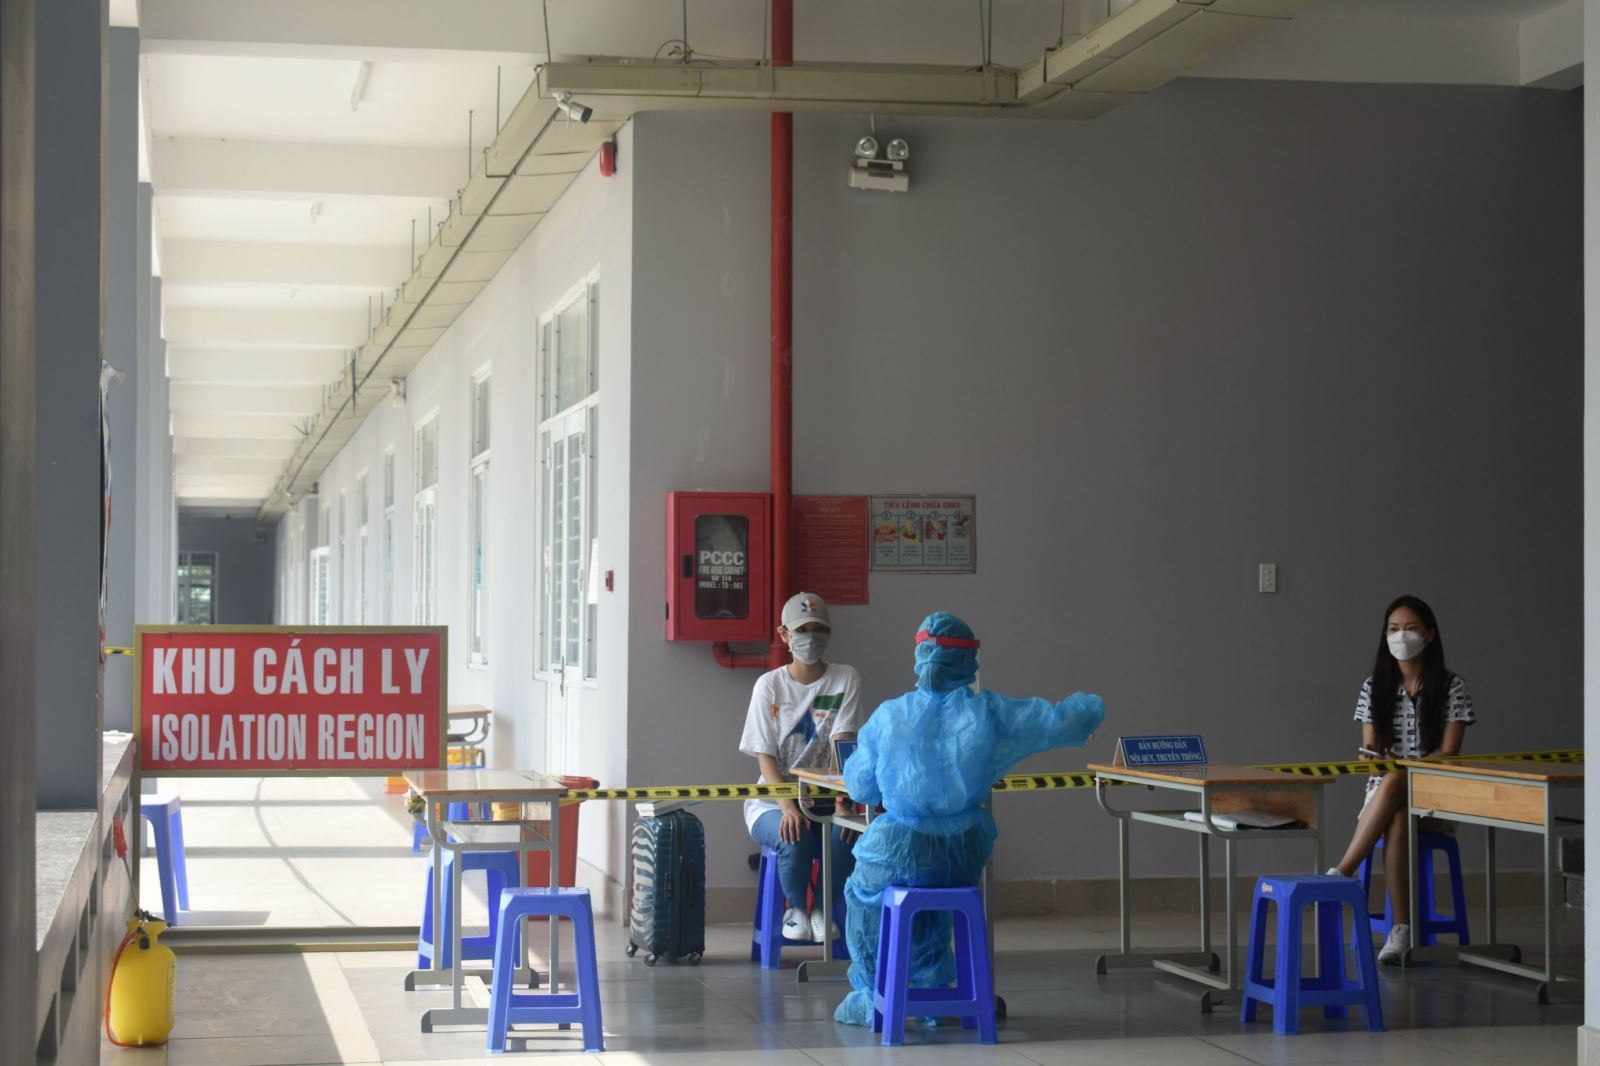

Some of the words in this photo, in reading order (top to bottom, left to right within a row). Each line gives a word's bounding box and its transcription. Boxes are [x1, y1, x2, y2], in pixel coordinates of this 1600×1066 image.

[700, 550, 744, 565] PCCC
[152, 647, 236, 695] KHU
[253, 638, 364, 696] CÁCH
[381, 648, 430, 694] LY
[151, 713, 307, 761] ISOLATION
[317, 712, 425, 761] REGION
